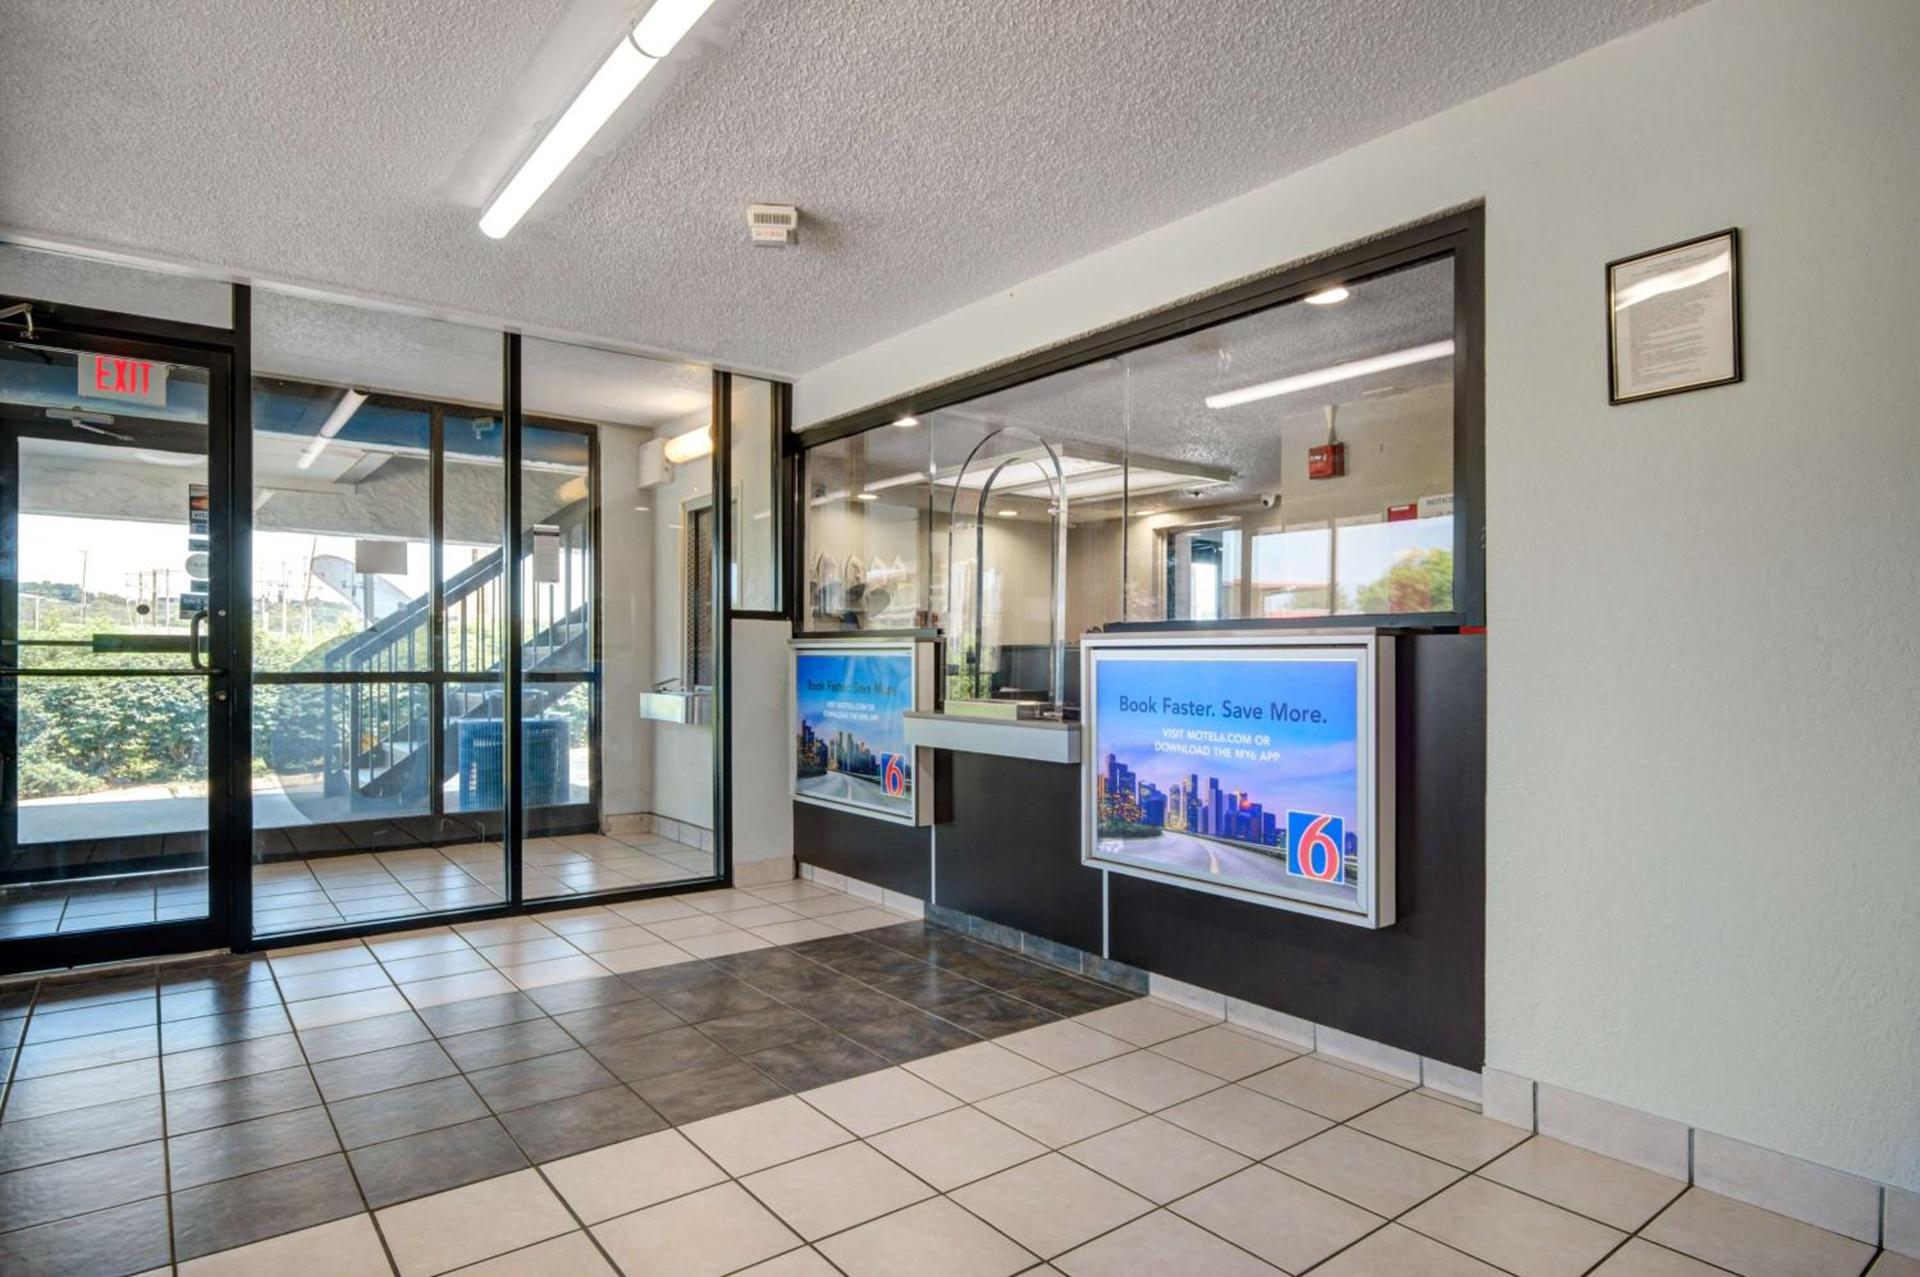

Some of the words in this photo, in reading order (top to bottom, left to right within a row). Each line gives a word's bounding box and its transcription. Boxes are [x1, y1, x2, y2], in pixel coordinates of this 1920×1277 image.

[95, 356, 153, 396] EXIT
[827, 680, 850, 693] Fast
[1119, 696, 1157, 714] Book
[1163, 697, 1215, 717] Faster.
[1222, 700, 1263, 720] Save
[1270, 702, 1327, 724] More.
[1155, 741, 1210, 756] DOWNLOAD
[1214, 747, 1232, 758] THE
[1235, 749, 1256, 760] MY6
[1260, 751, 1281, 761] APP
[1162, 728, 1184, 738] VISIT
[1187, 729, 1251, 745] MOTEL6.COM
[1255, 735, 1271, 746] OR
[885, 752, 904, 797] 6
[1297, 814, 1340, 883] 6
